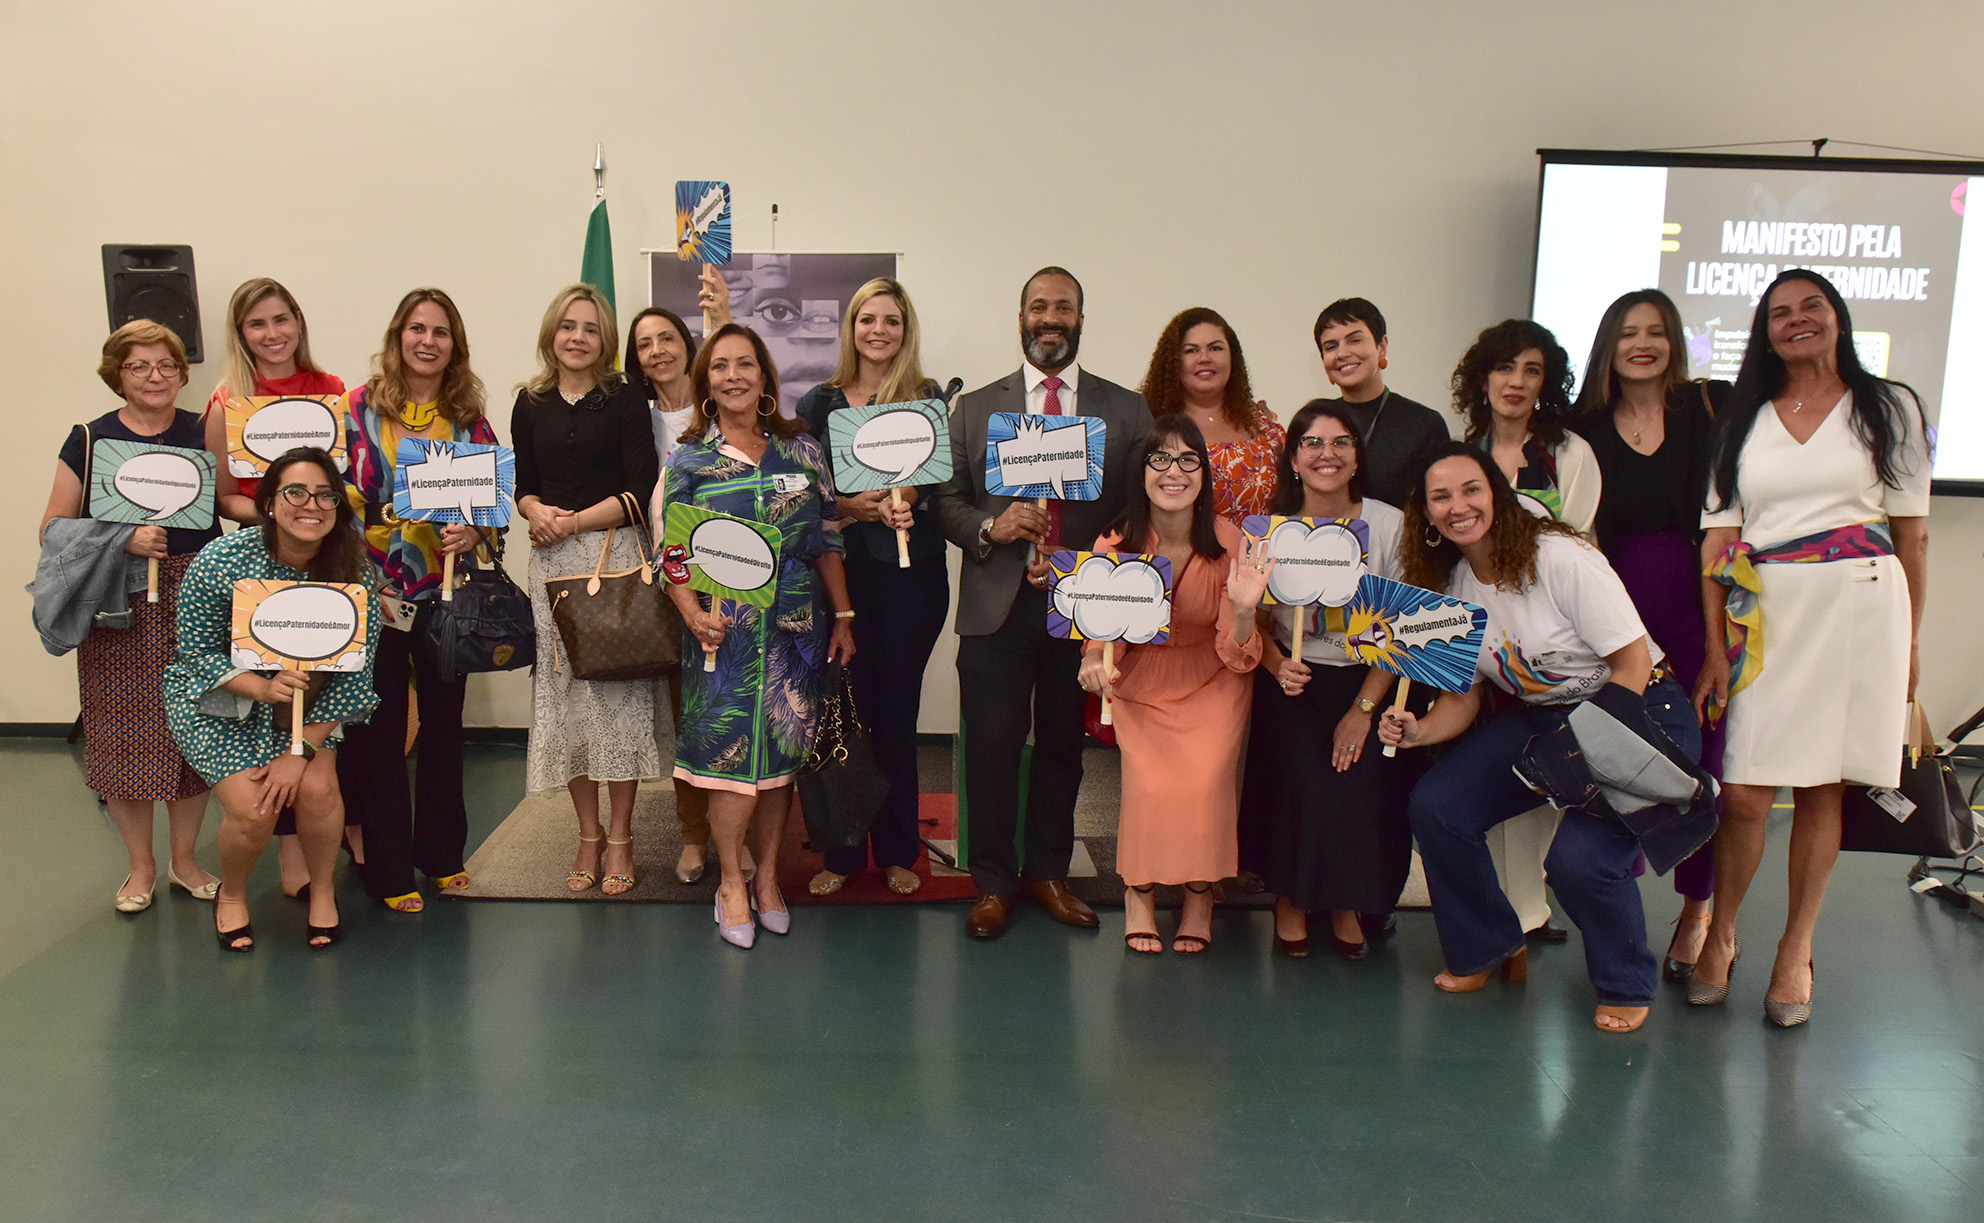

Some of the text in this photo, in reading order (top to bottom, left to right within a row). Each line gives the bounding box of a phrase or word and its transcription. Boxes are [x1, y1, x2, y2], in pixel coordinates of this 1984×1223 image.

[1721, 220, 1902, 259] MANIFESTO PELA
[246, 431, 331, 441] #LicençaPaternidadeéAmor
[1002, 450, 1084, 466] #LicençaPaternidade
[411, 477, 494, 491] #LicençaPaternidade
[694, 545, 772, 570] #LicençaPaternidadeéDireito
[1067, 592, 1154, 603] #LicençaPaternidadeéEquidade
[254, 619, 351, 630] #LicençaPaternidadeéAmor
[1399, 614, 1468, 635] #RegulamentaJá
[1566, 686, 1581, 698] do
[1578, 663, 1607, 689] Brasil
